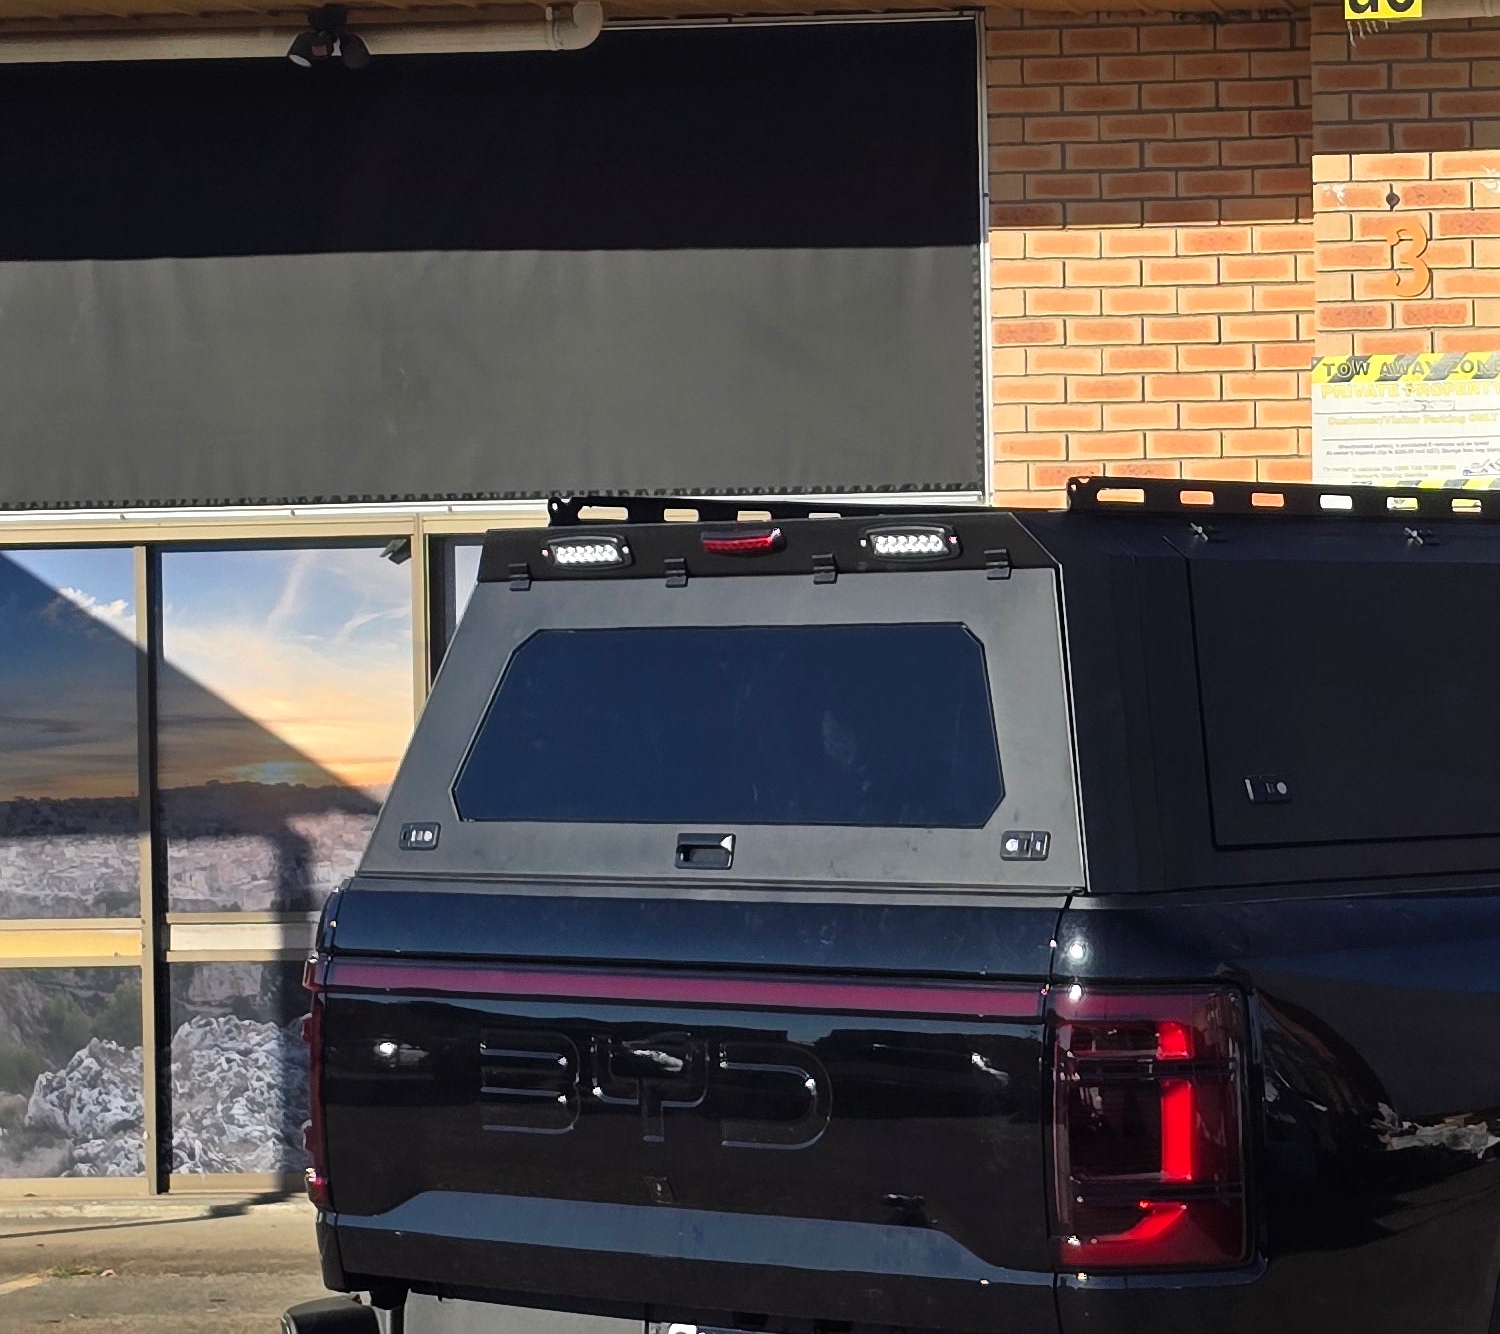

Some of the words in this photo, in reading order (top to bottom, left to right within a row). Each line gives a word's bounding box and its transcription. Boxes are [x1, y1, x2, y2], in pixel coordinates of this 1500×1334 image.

[1386, 222, 1432, 297] 3
[1321, 384, 1400, 399] PRIVATE
[1323, 360, 1371, 378] TOW
[1379, 359, 1438, 377] AWAY
[479, 1027, 834, 1151] BYD
